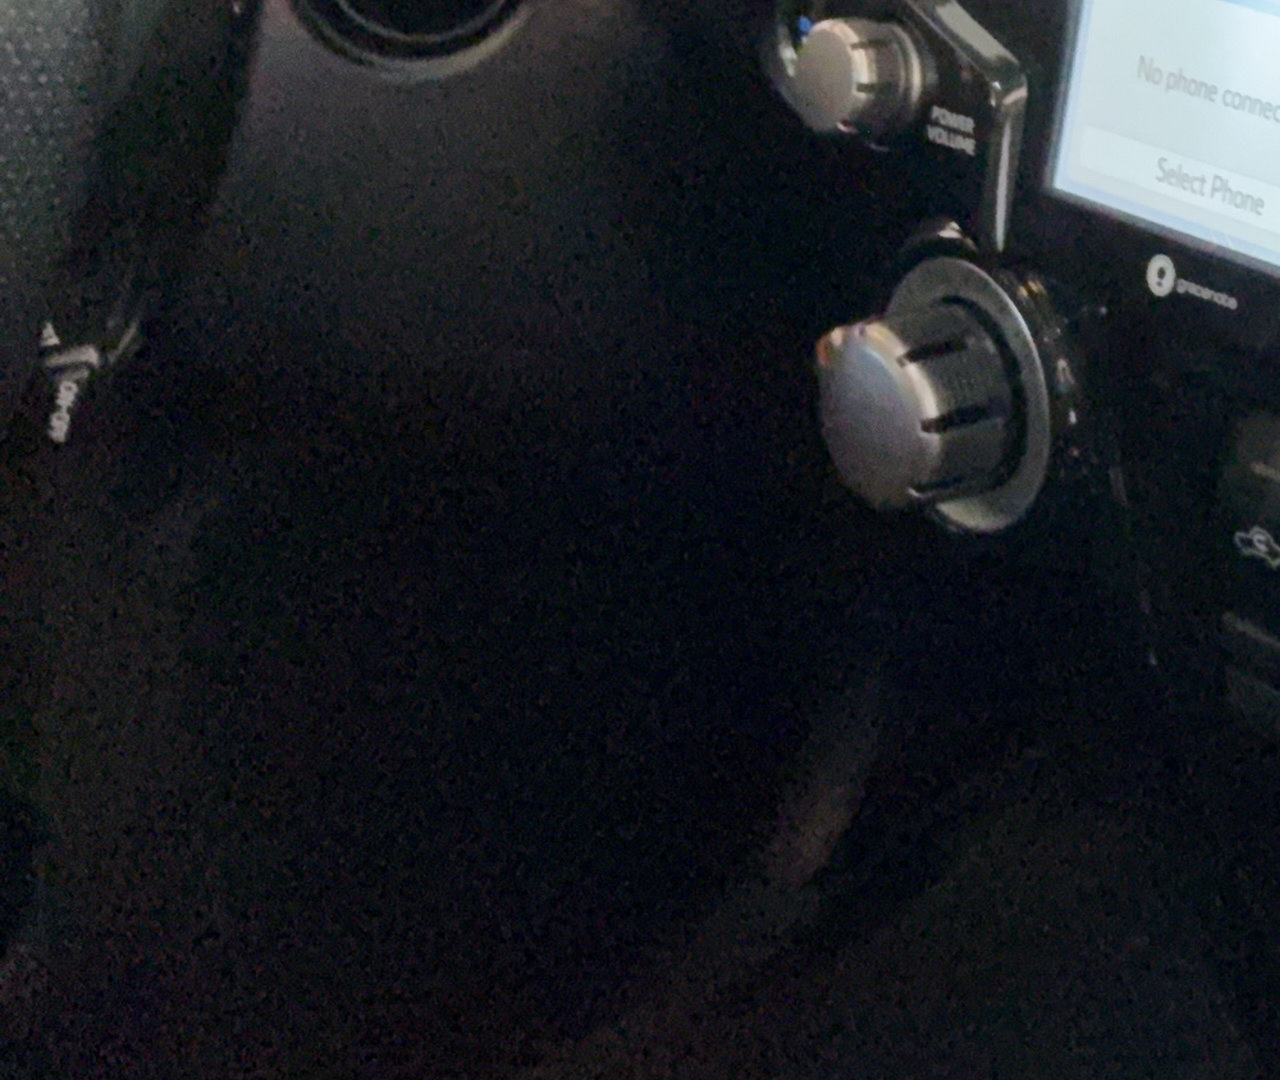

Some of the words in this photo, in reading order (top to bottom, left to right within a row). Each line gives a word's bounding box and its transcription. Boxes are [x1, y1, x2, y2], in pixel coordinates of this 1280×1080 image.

[1137, 55, 1163, 86] No
[1166, 66, 1219, 103] phone
[1155, 156, 1206, 197] Select
[1211, 174, 1265, 216] Phone
